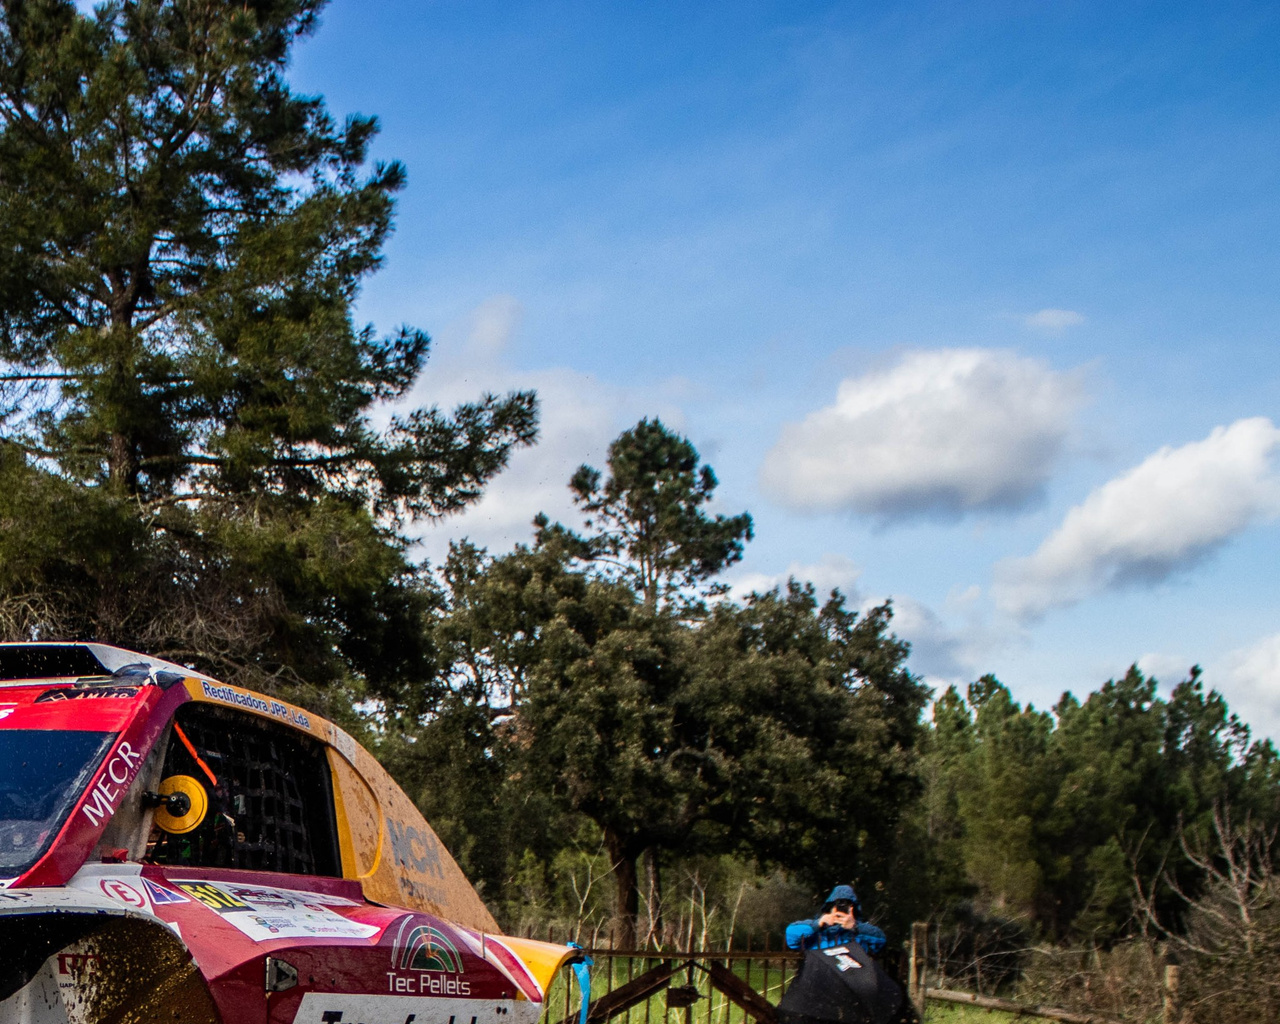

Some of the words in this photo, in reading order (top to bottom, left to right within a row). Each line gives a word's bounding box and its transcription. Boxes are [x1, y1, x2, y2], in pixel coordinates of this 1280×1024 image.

[201, 680, 269, 712] Rectificadora
[292, 710, 310, 729] Lda
[82, 741, 140, 827] MECR
[109, 883, 136, 903] E
[179, 884, 249, 909] 512
[386, 972, 416, 993] Tec
[420, 974, 472, 996] Pellets
